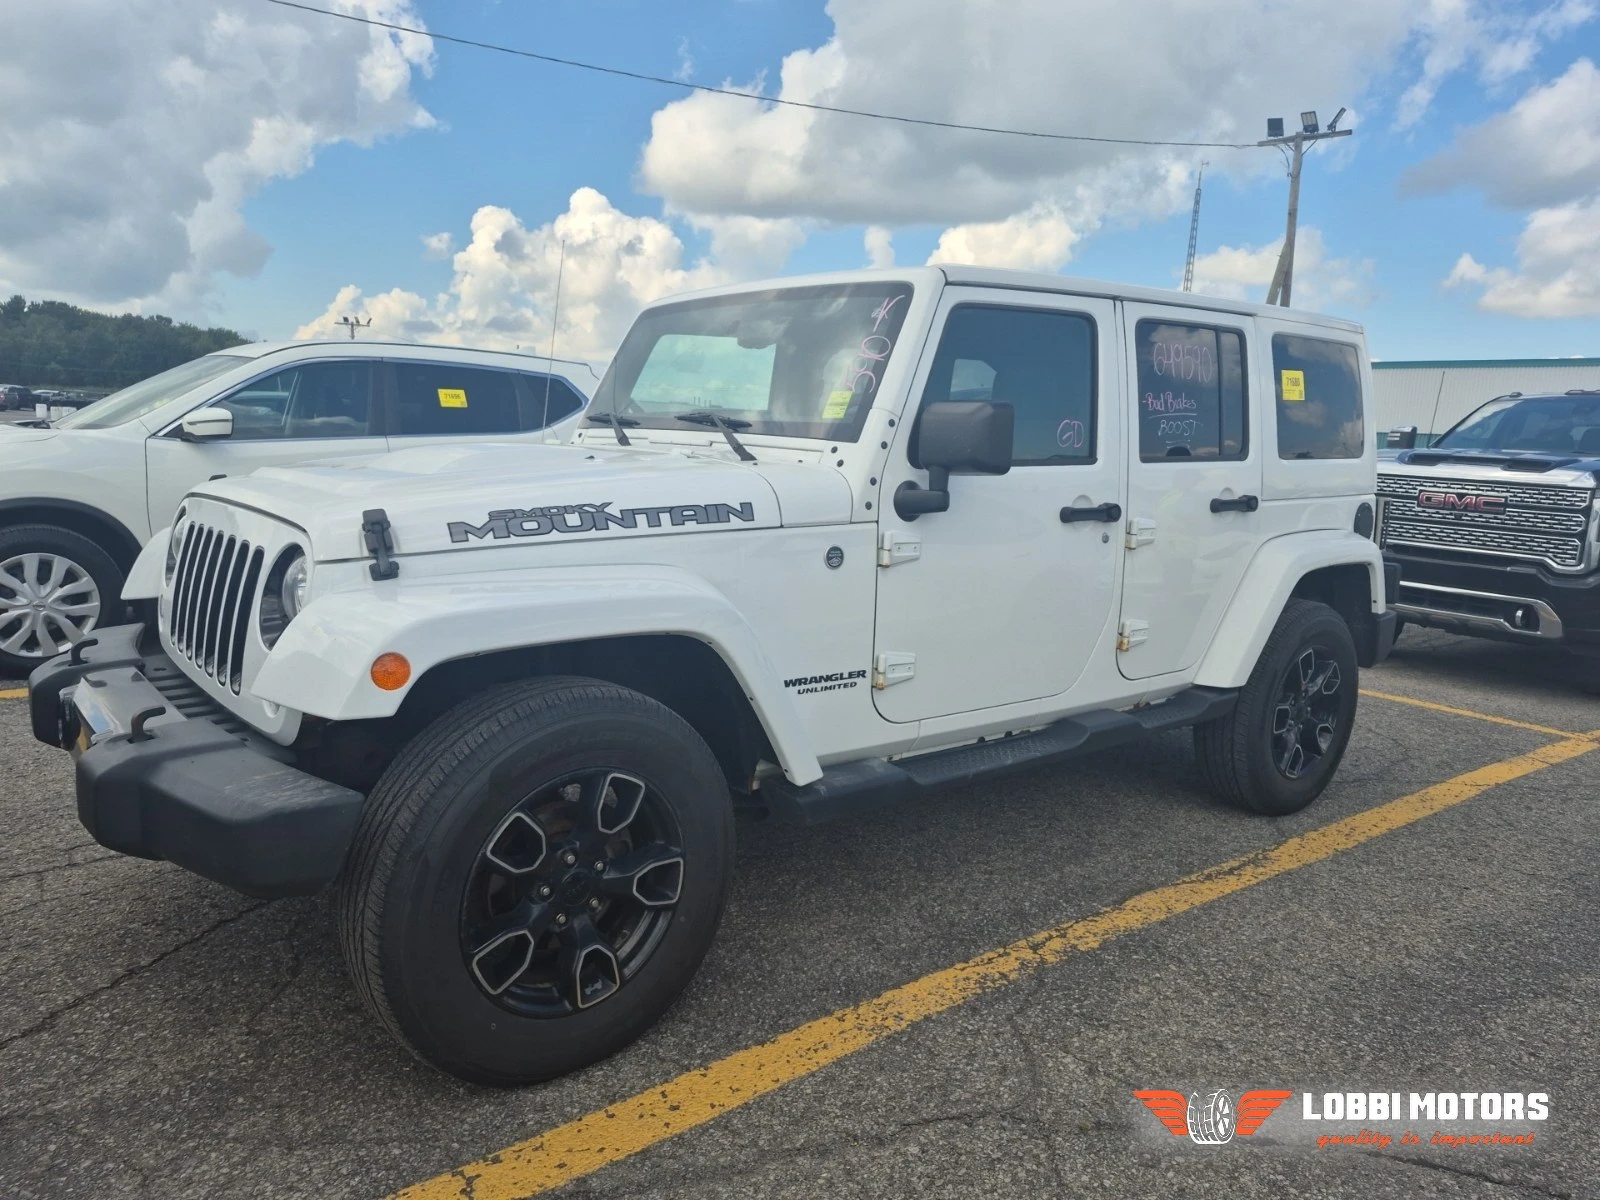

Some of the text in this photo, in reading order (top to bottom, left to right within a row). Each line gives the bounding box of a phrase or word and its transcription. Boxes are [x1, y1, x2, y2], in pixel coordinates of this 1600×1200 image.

[1153, 342, 1212, 382] 649590
[488, 502, 613, 520] SMOKY
[1419, 491, 1506, 512] GMC
[447, 502, 755, 543] MOUNTAIN
[783, 669, 867, 688] WRANGLER
[797, 681, 857, 695] UNLIMITED
